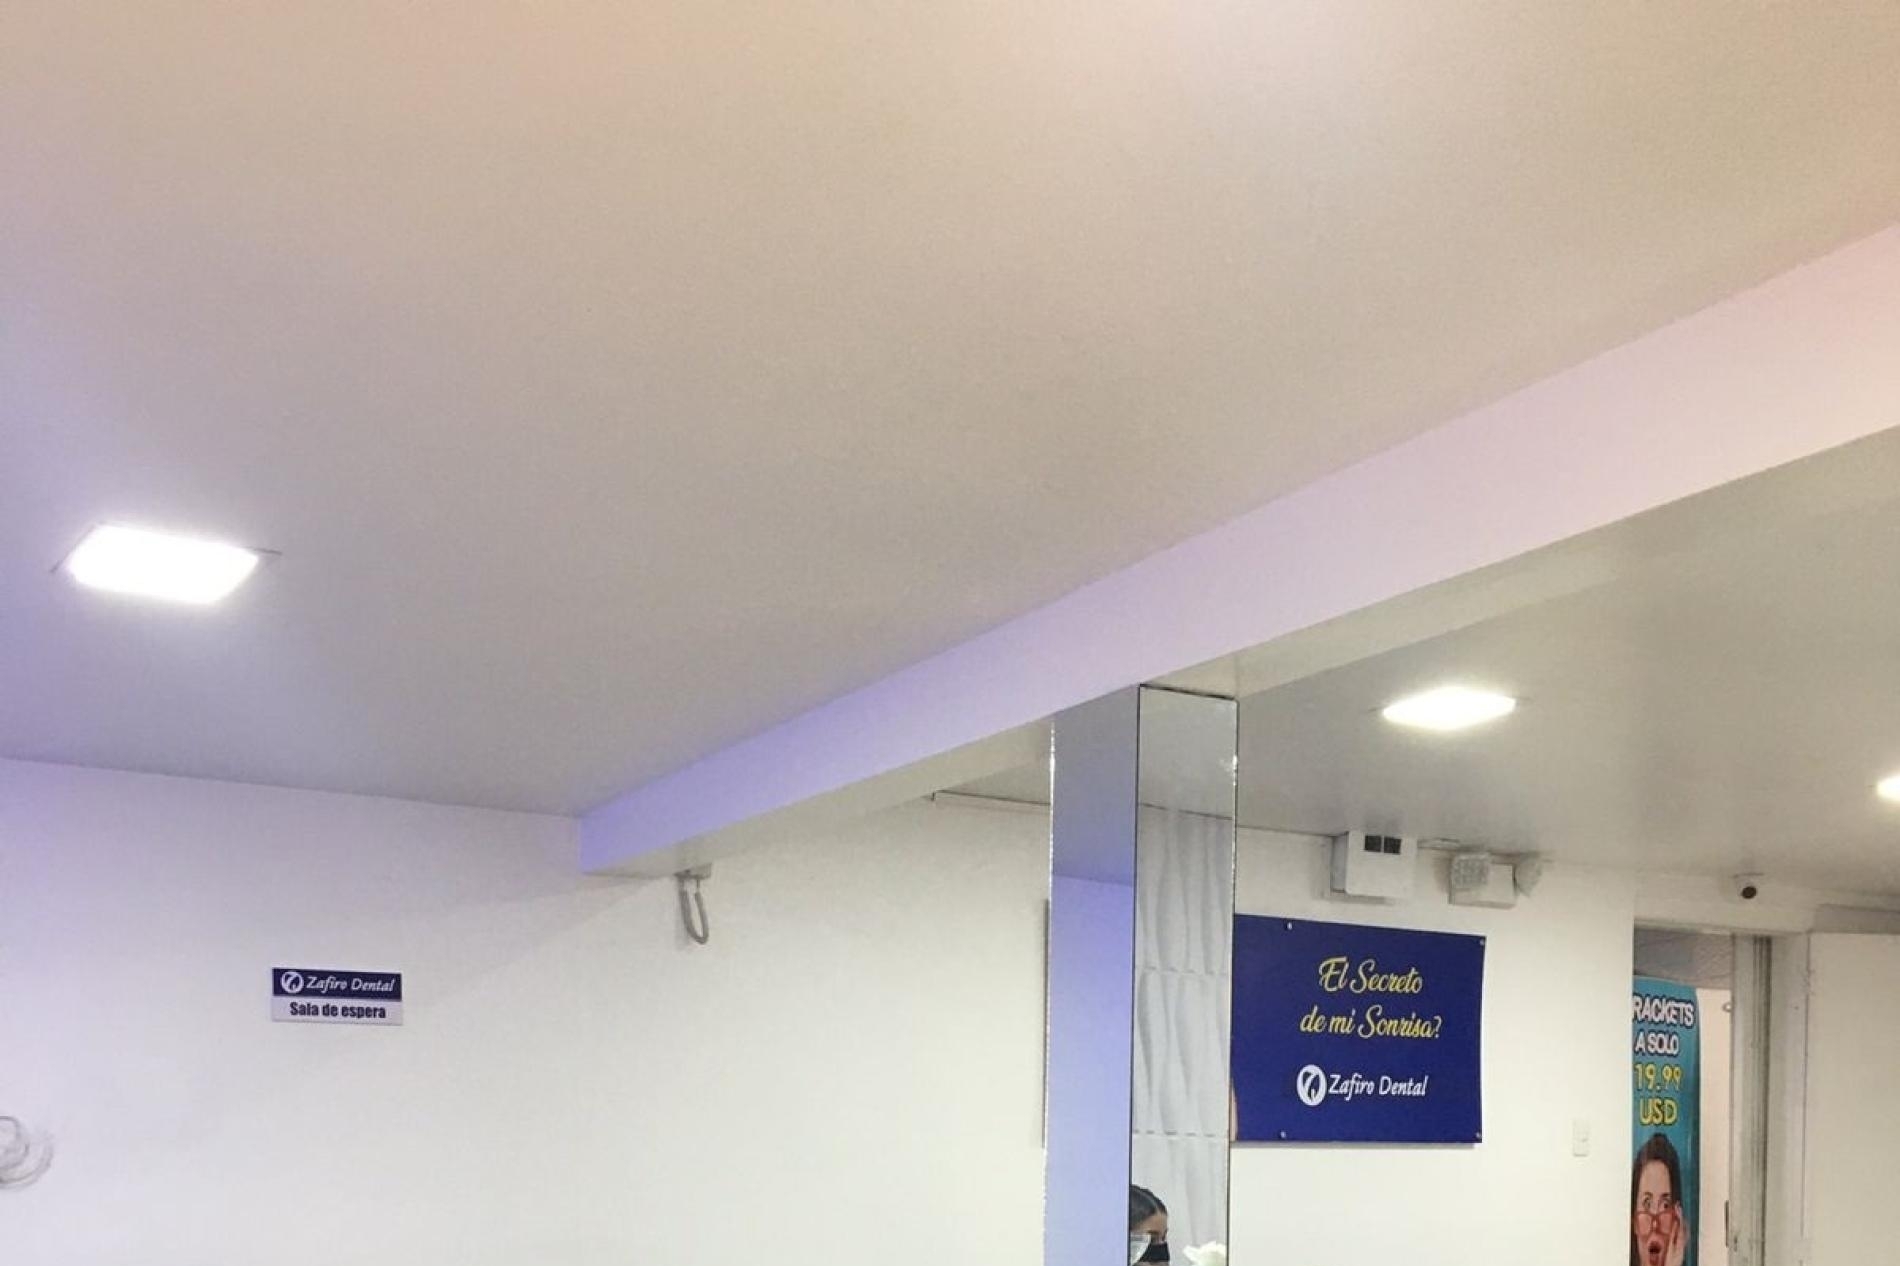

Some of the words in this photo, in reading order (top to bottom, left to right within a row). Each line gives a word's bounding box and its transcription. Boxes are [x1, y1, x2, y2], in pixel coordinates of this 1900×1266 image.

[306, 975, 348, 993] Zafiro
[351, 978, 395, 992] Dental
[1318, 956, 1349, 992] El
[1350, 959, 1423, 994] Secreto
[290, 1002, 319, 1016] Sala
[322, 1004, 338, 1017] de
[341, 1005, 386, 1019] espera
[1300, 1006, 1325, 1033] de
[1329, 1009, 1355, 1034] mi
[1357, 1004, 1442, 1039] Sonrisa?
[1633, 996, 1694, 1027] RACKETS
[1635, 1031, 1646, 1053] A
[1647, 1033, 1680, 1056] SOLO
[1329, 1074, 1374, 1101] Zafiro
[1379, 1075, 1428, 1096] Dental
[1634, 1063, 1684, 1091] 19.99
[1640, 1098, 1677, 1124] USD
